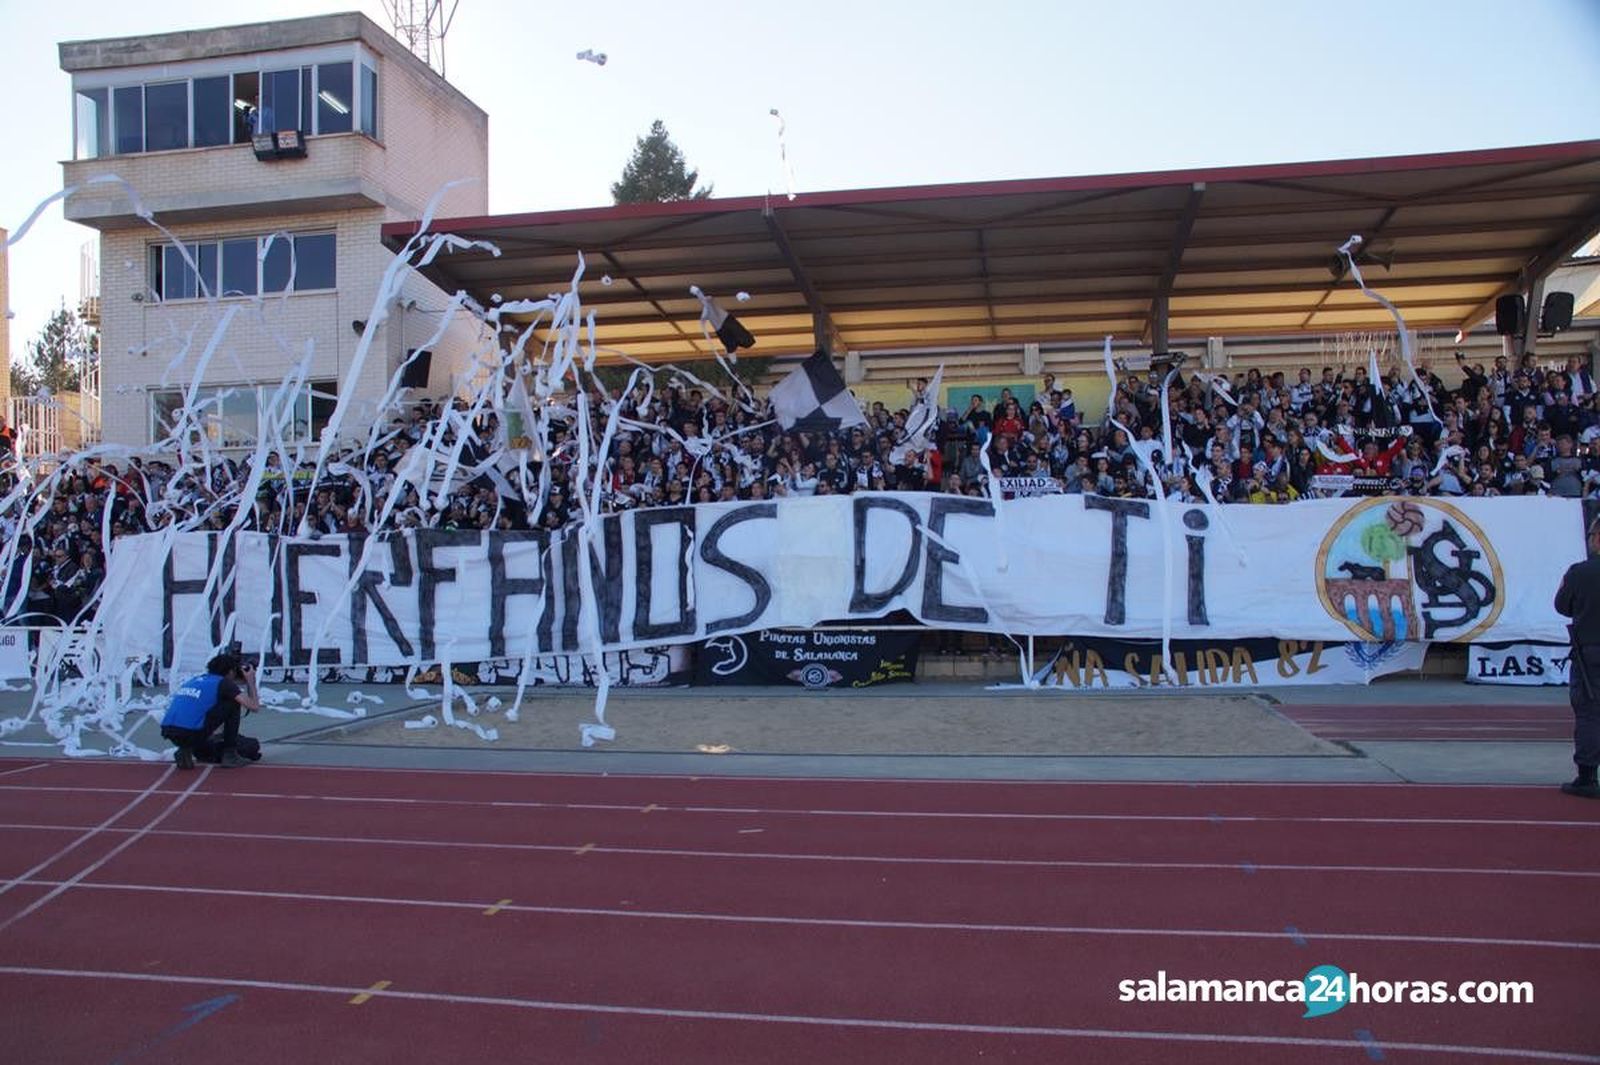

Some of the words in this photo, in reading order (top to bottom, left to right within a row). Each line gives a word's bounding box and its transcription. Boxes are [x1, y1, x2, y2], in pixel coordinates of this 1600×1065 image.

[1000, 479, 1058, 488] EXILIAD
[848, 497, 996, 624] DE
[813, 631, 877, 646] UNIONISTAS
[775, 651, 790, 660] DE
[794, 648, 859, 662] SALAMANCA
[1477, 656, 1545, 677] LAS
